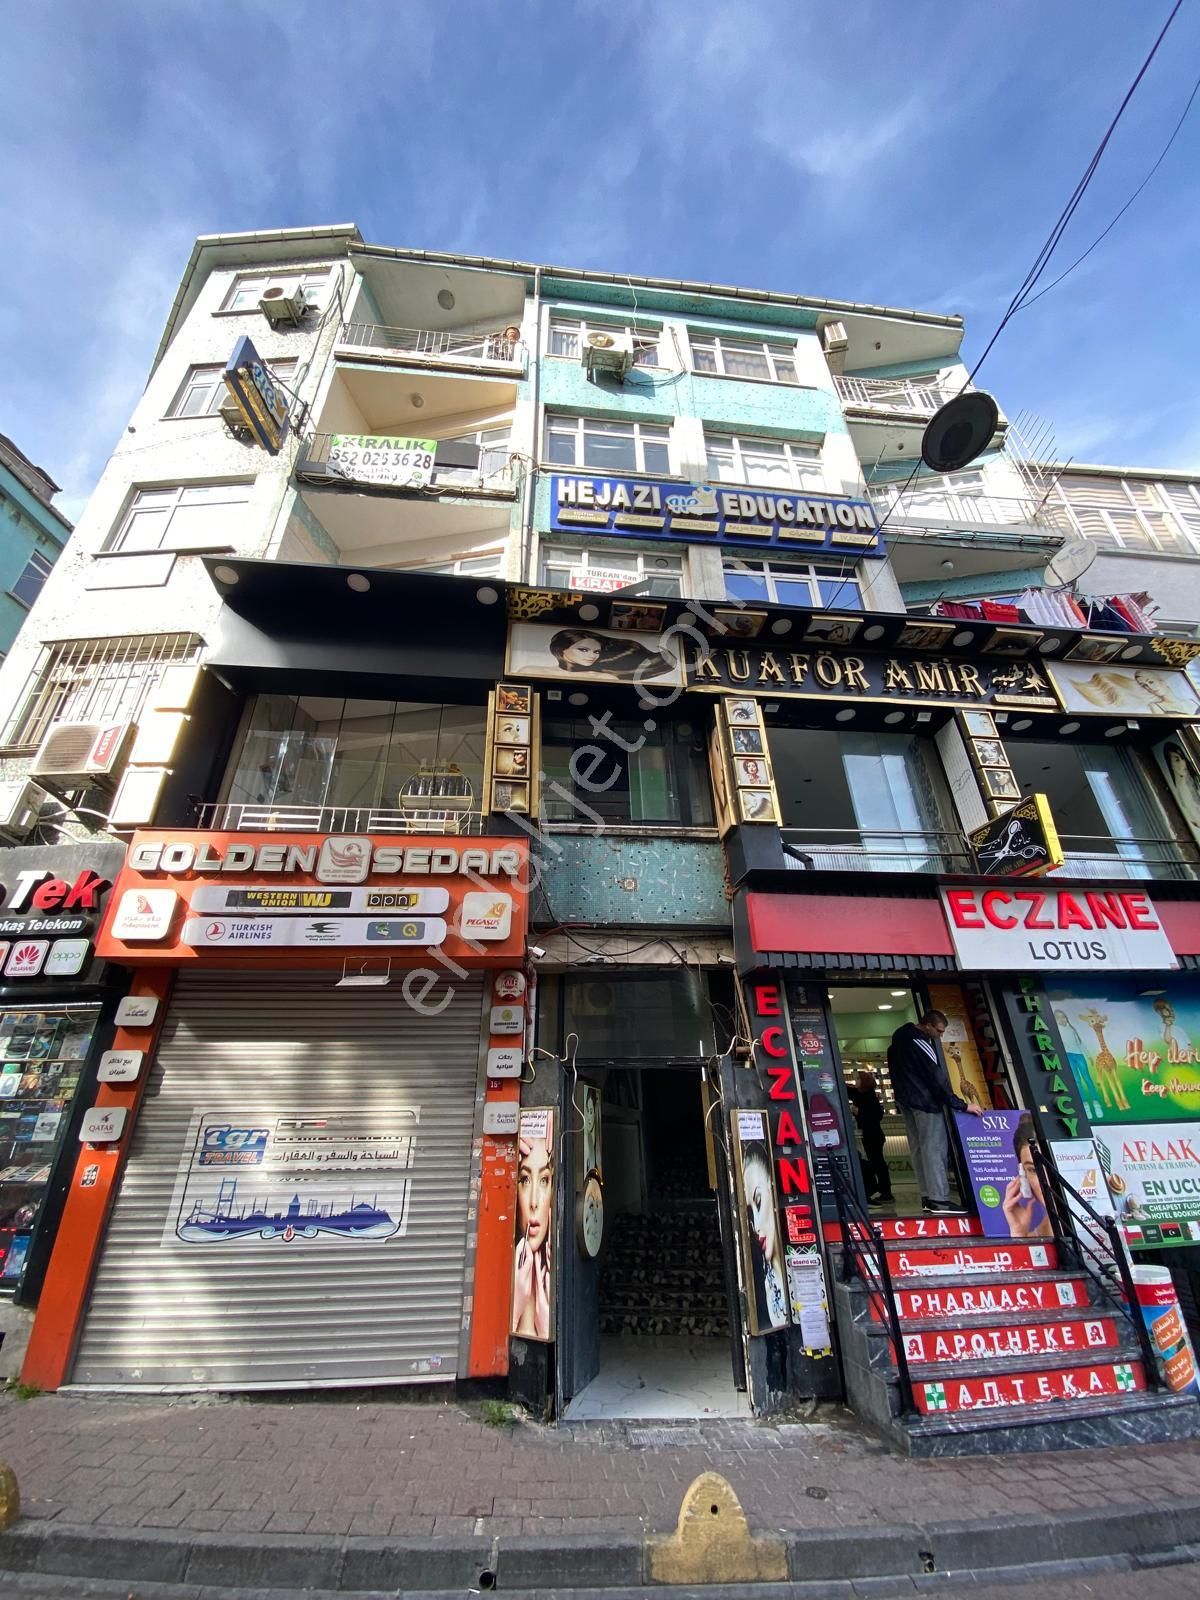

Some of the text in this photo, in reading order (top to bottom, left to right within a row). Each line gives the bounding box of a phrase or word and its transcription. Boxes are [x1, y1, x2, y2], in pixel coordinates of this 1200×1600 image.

[392, 453, 409, 466] 36
[413, 453, 432, 469] 28
[558, 479, 661, 508] HEJAZI
[722, 492, 876, 528] EDUCATION
[694, 647, 870, 690] KUAFÖR
[886, 658, 987, 696] AMİR
[128, 843, 521, 876] GOLDEN SEDAR
[8, 869, 105, 909] Tek
[301, 892, 331, 907] WU
[946, 889, 1159, 930] ECZANE
[28, 919, 82, 931] Telekom
[466, 918, 500, 926] PEGASUS
[228, 931, 272, 939] AIRLINES
[1028, 941, 1107, 960] LOTUS
[1017, 977, 1078, 1138] PHARMACY
[753, 984, 816, 1244] ECZANE
[982, 1116, 1010, 1130] SVR
[204, 1152, 258, 1163] TRAVEL
[1056, 1152, 1086, 1162] Ethiopian
[1122, 1139, 1200, 1166] AFAAK
[1124, 1163, 1157, 1171] TOURISM
[1165, 1161, 1196, 1169] TRADING
[1142, 1180, 1167, 1195] EN
[1149, 1203, 1182, 1211] CHEAPEST
[910, 1286, 1044, 1312] PHARMACY
[934, 1326, 1075, 1355] APOTHEKE
[958, 1371, 1103, 1404] АПТЕКА
